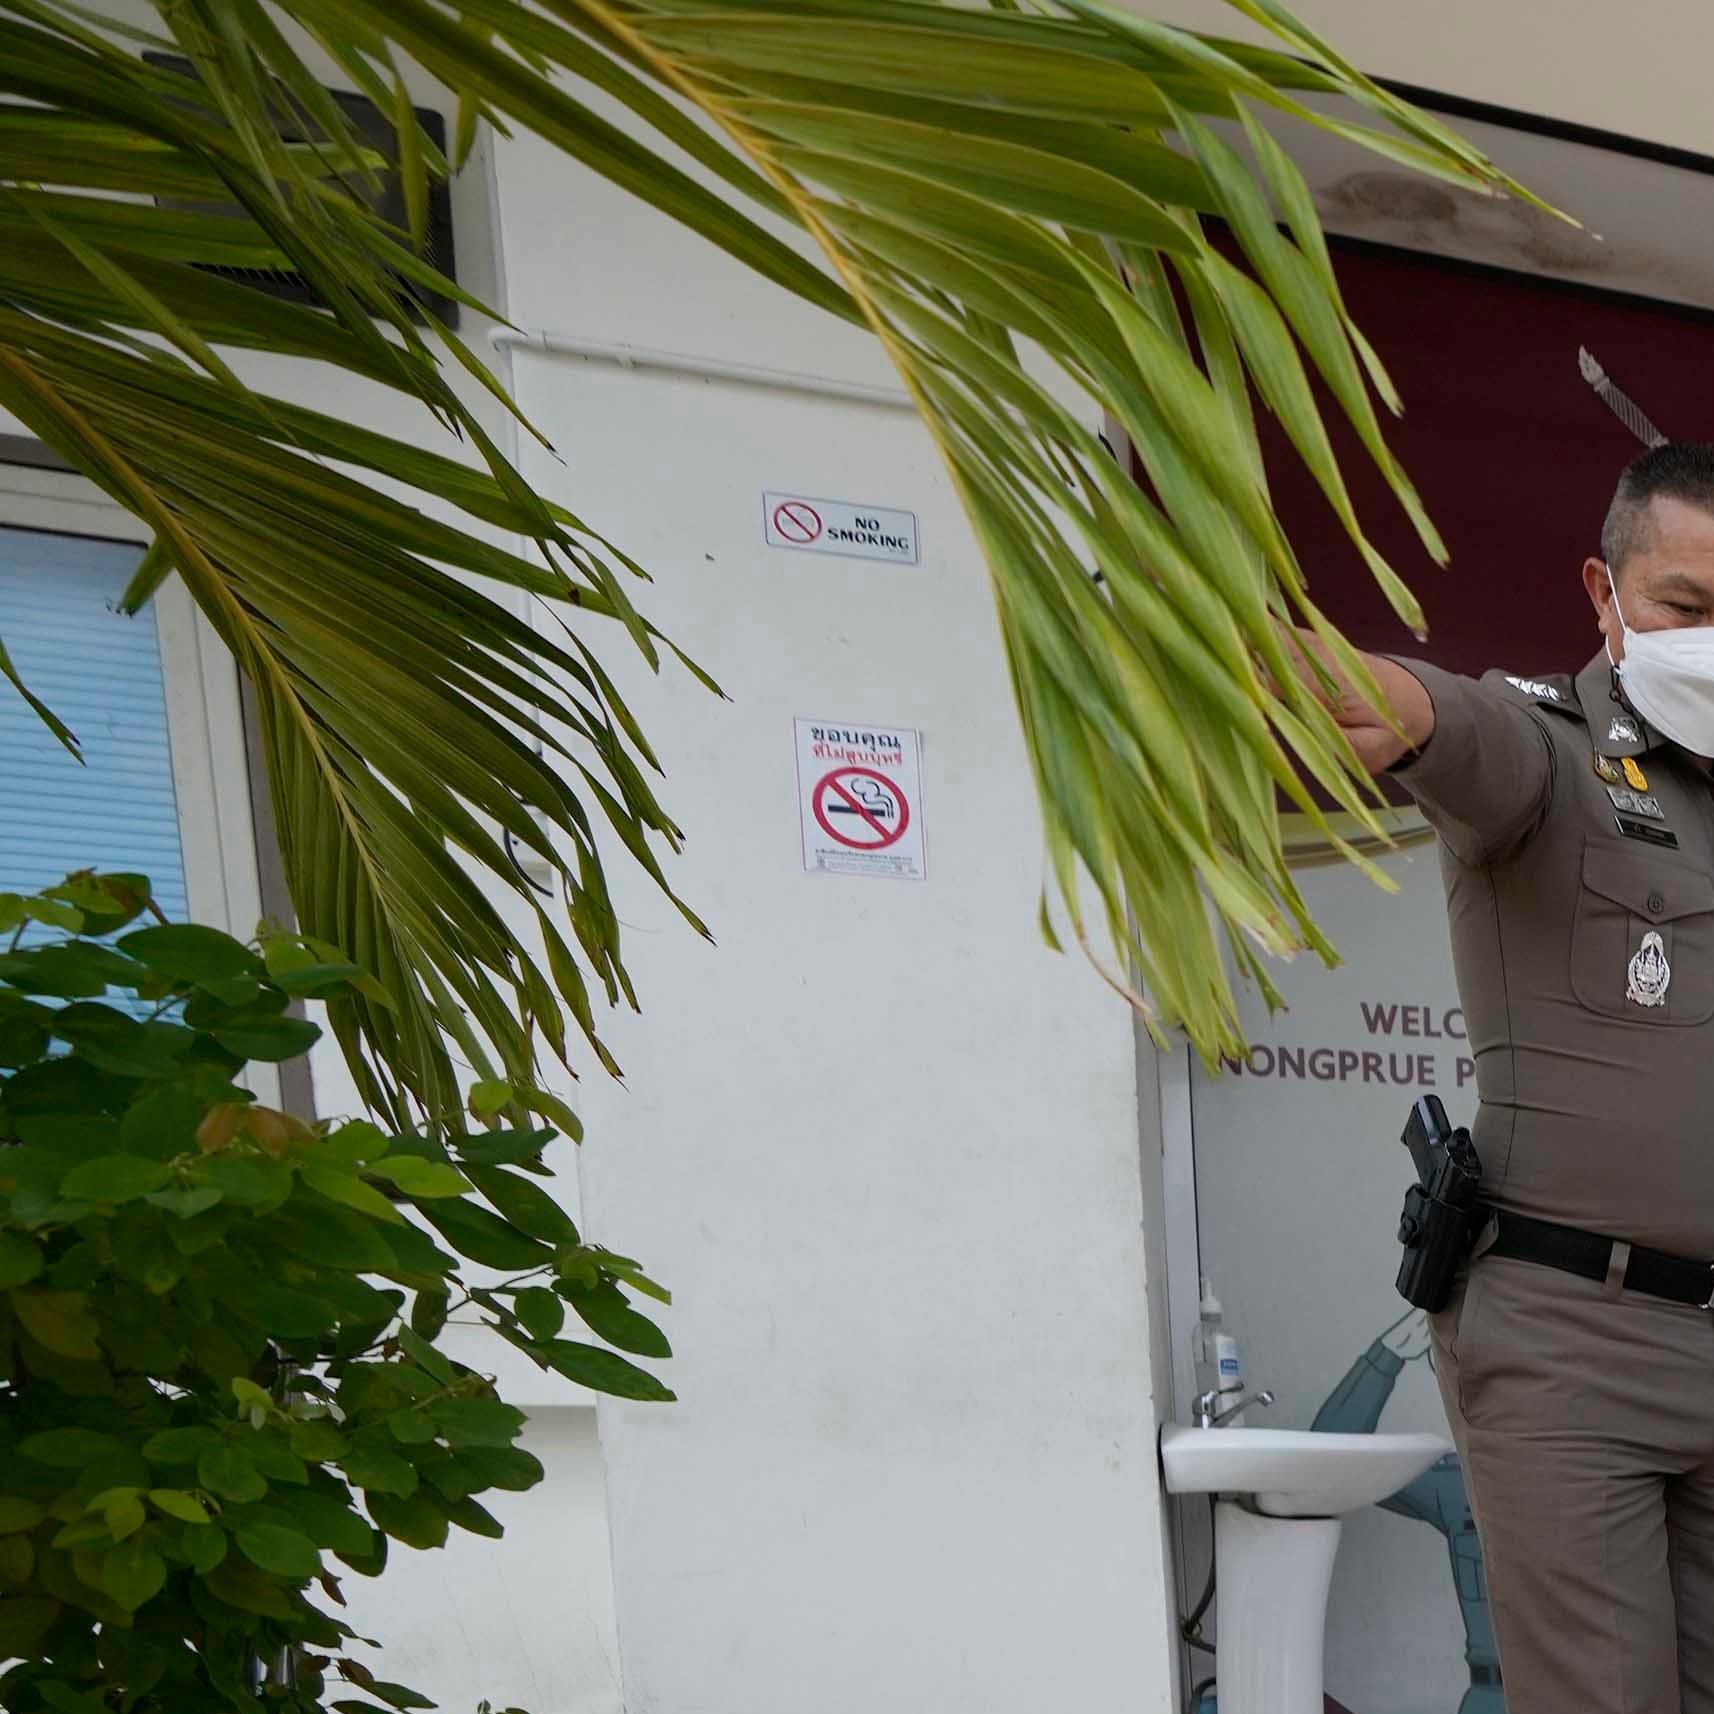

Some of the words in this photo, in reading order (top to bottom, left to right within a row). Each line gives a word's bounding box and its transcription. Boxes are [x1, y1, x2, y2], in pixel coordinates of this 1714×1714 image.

[855, 516, 880, 531] NO
[827, 527, 909, 550] SMOKING
[811, 727, 901, 752] ขอบคุณ
[1360, 1002, 1466, 1039] WELC
